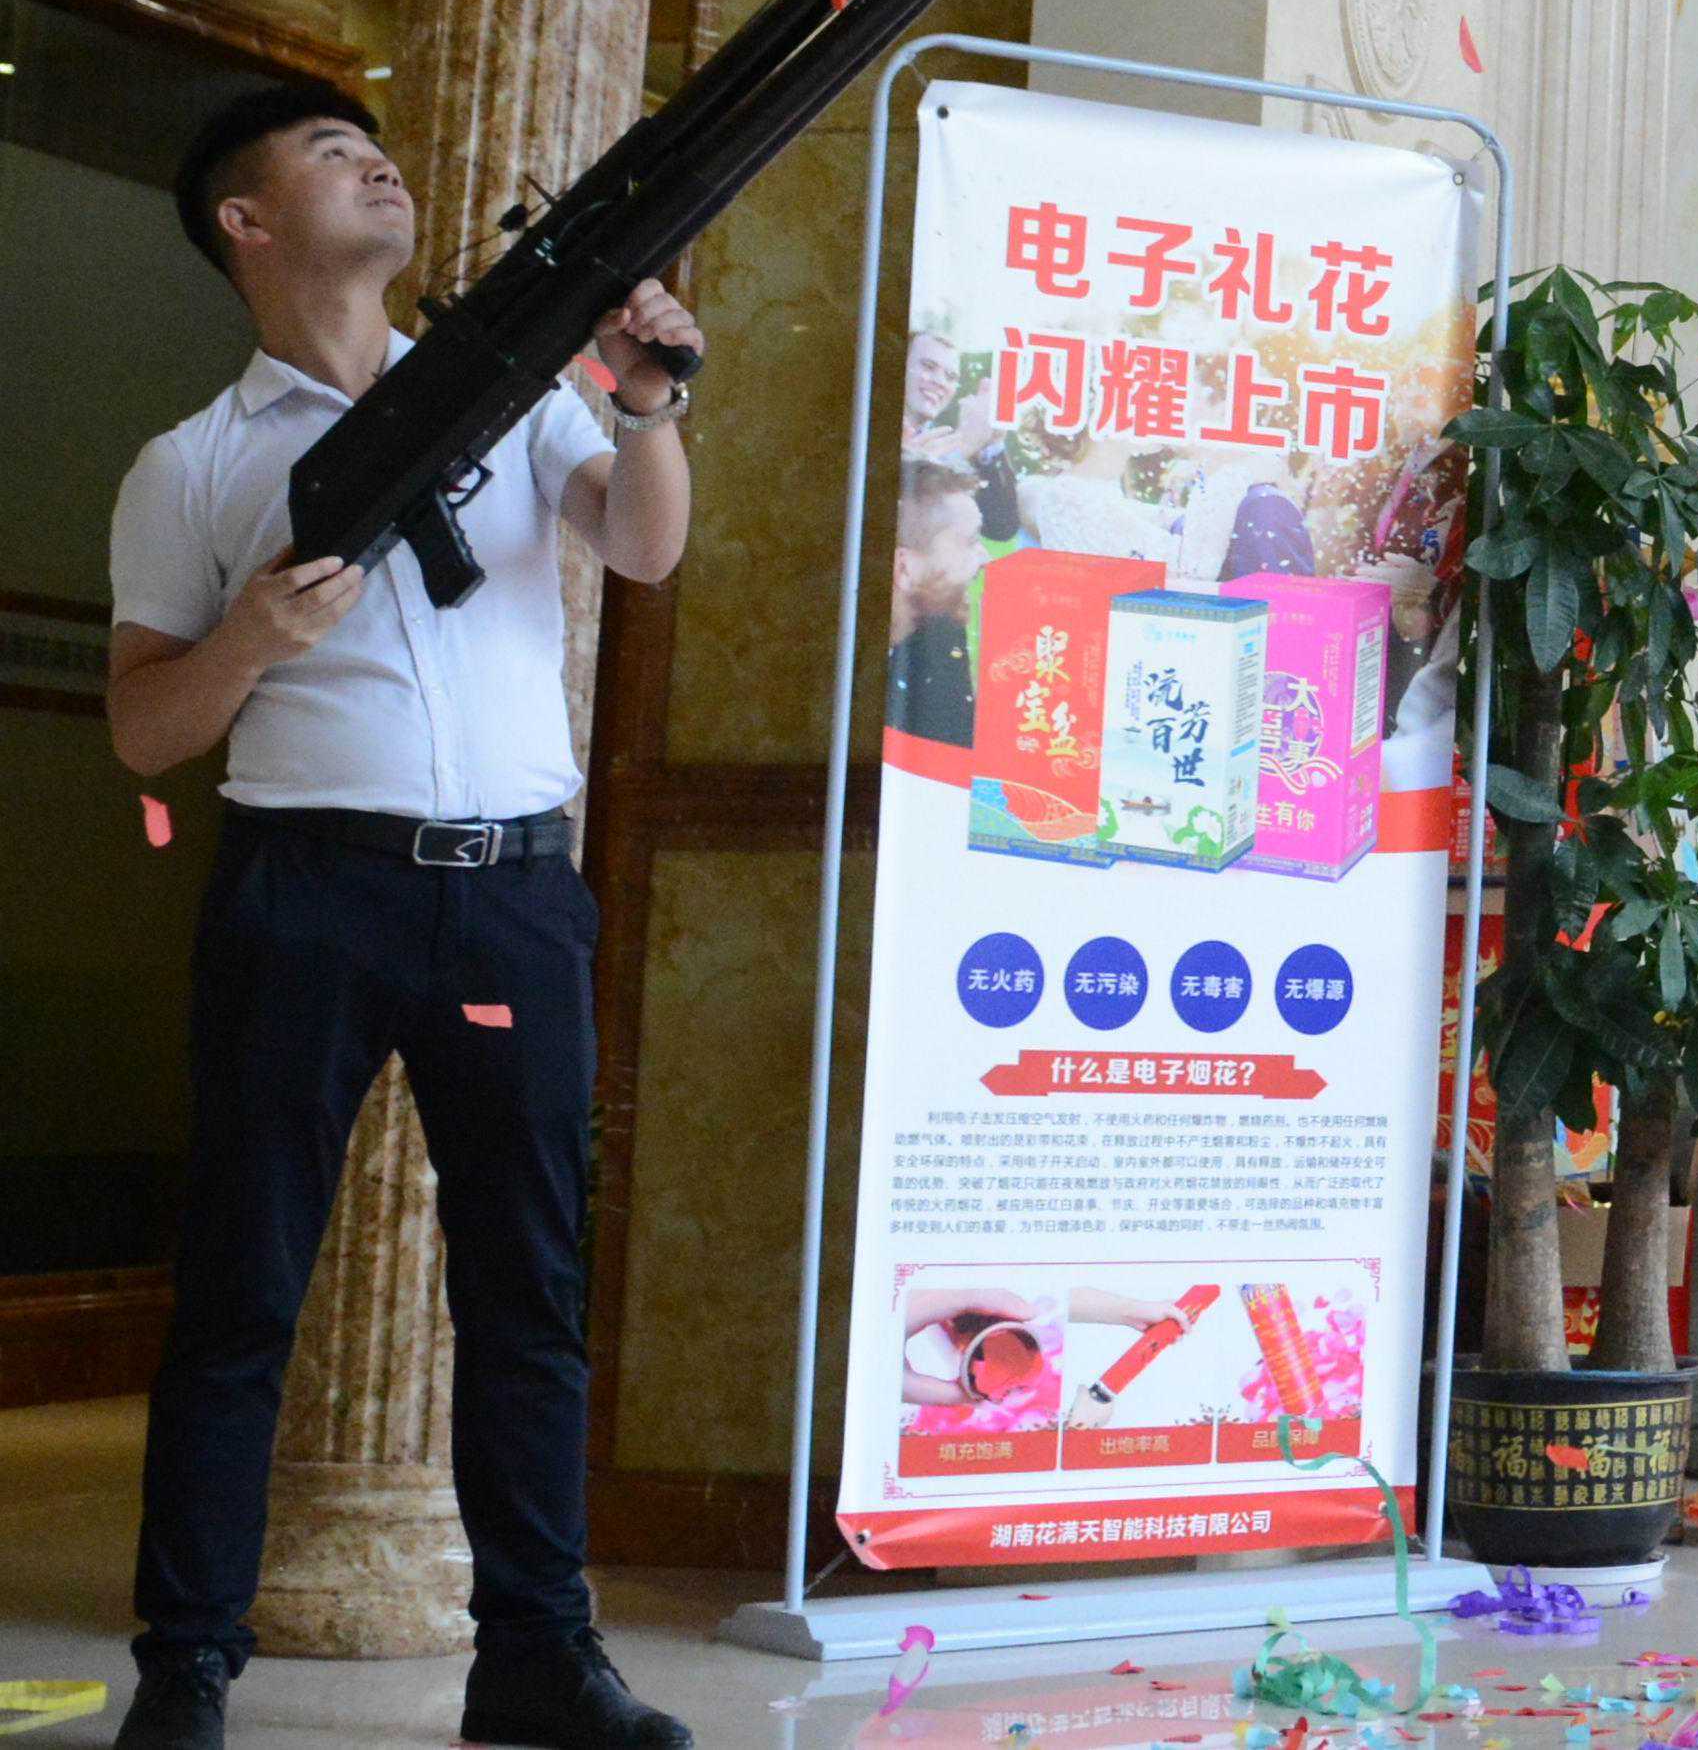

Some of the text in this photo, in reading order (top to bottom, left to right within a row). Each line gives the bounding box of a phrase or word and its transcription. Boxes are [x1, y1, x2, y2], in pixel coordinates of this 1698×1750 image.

[1005, 202, 1393, 336] 电子礼花
[995, 327, 1386, 460] 闪耀上市
[968, 969, 1036, 994] 无火药
[1074, 972, 1140, 996] 无污染
[1180, 975, 1245, 999] 无毒害
[990, 1509, 1273, 1549] 湖南花满天智能科技有限公司
